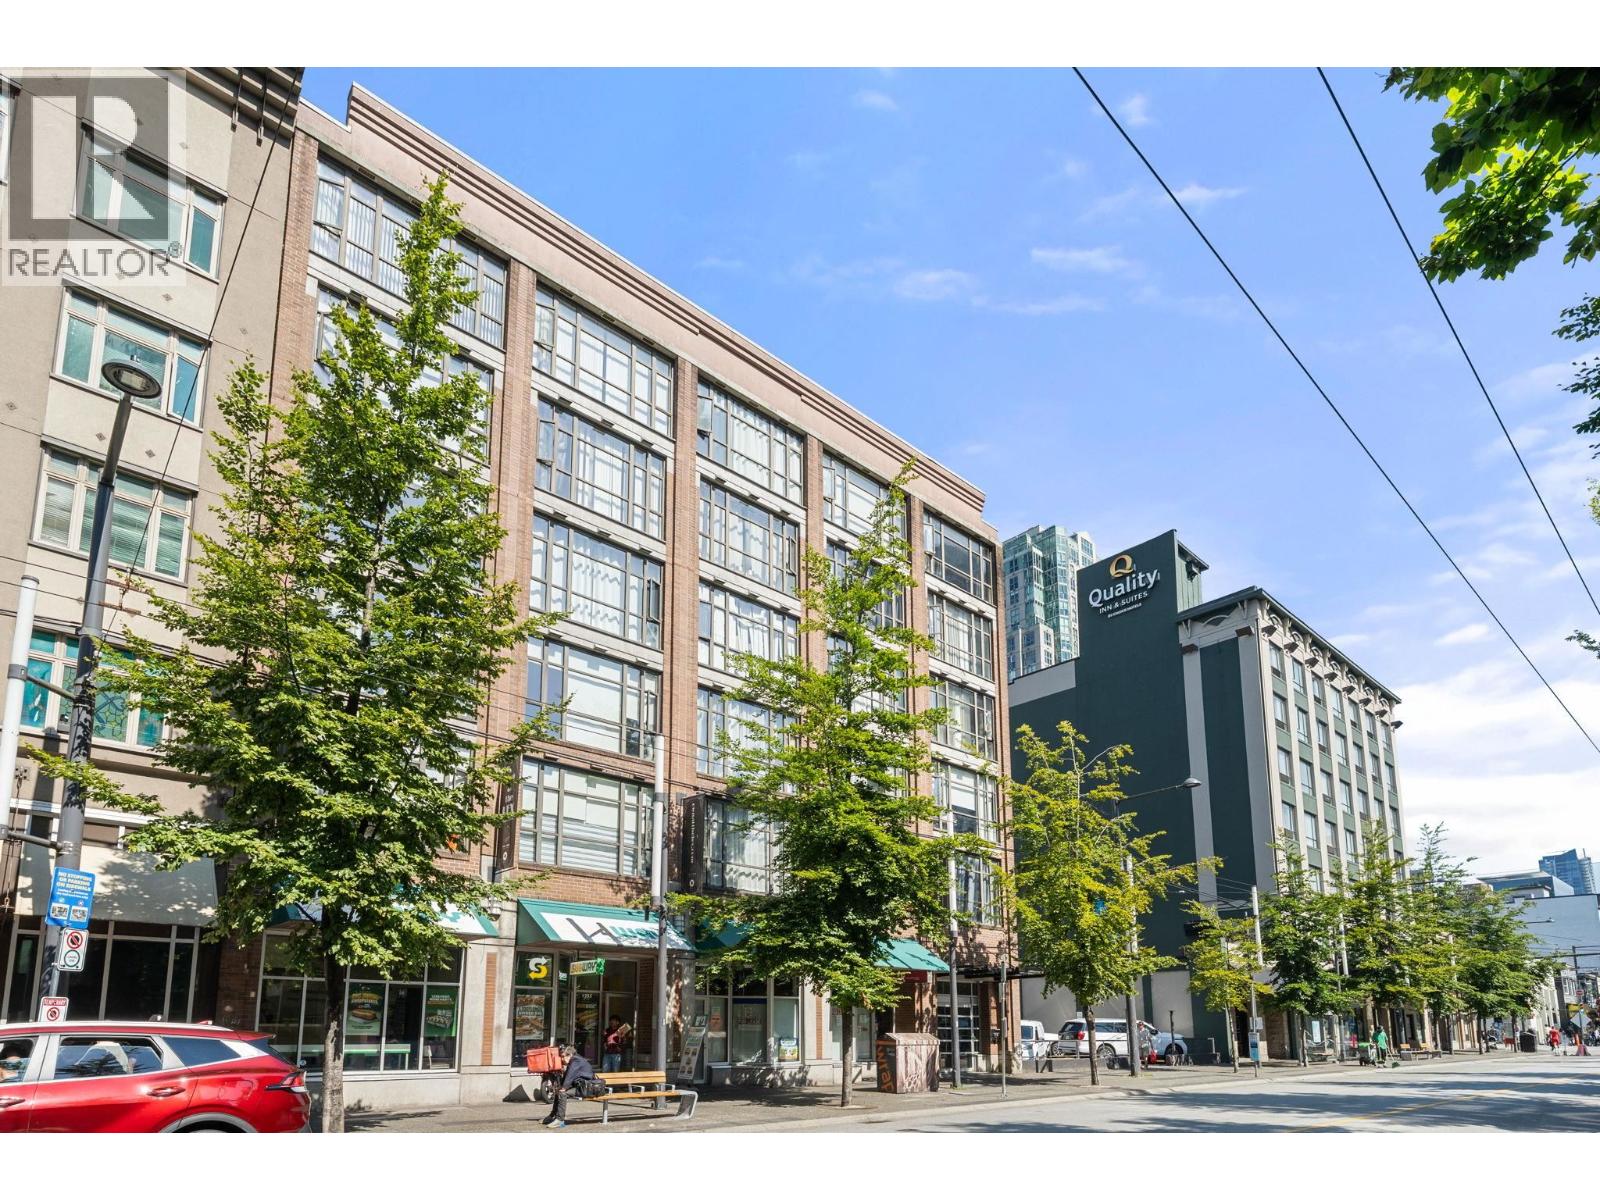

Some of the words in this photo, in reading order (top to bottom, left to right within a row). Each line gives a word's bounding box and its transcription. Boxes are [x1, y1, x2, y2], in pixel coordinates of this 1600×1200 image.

[1109, 554, 1134, 578] Q
[1088, 569, 1159, 607] Quality
[1099, 604, 1113, 614] INN
[1114, 601, 1120, 609] &
[1121, 590, 1148, 606] SUITES
